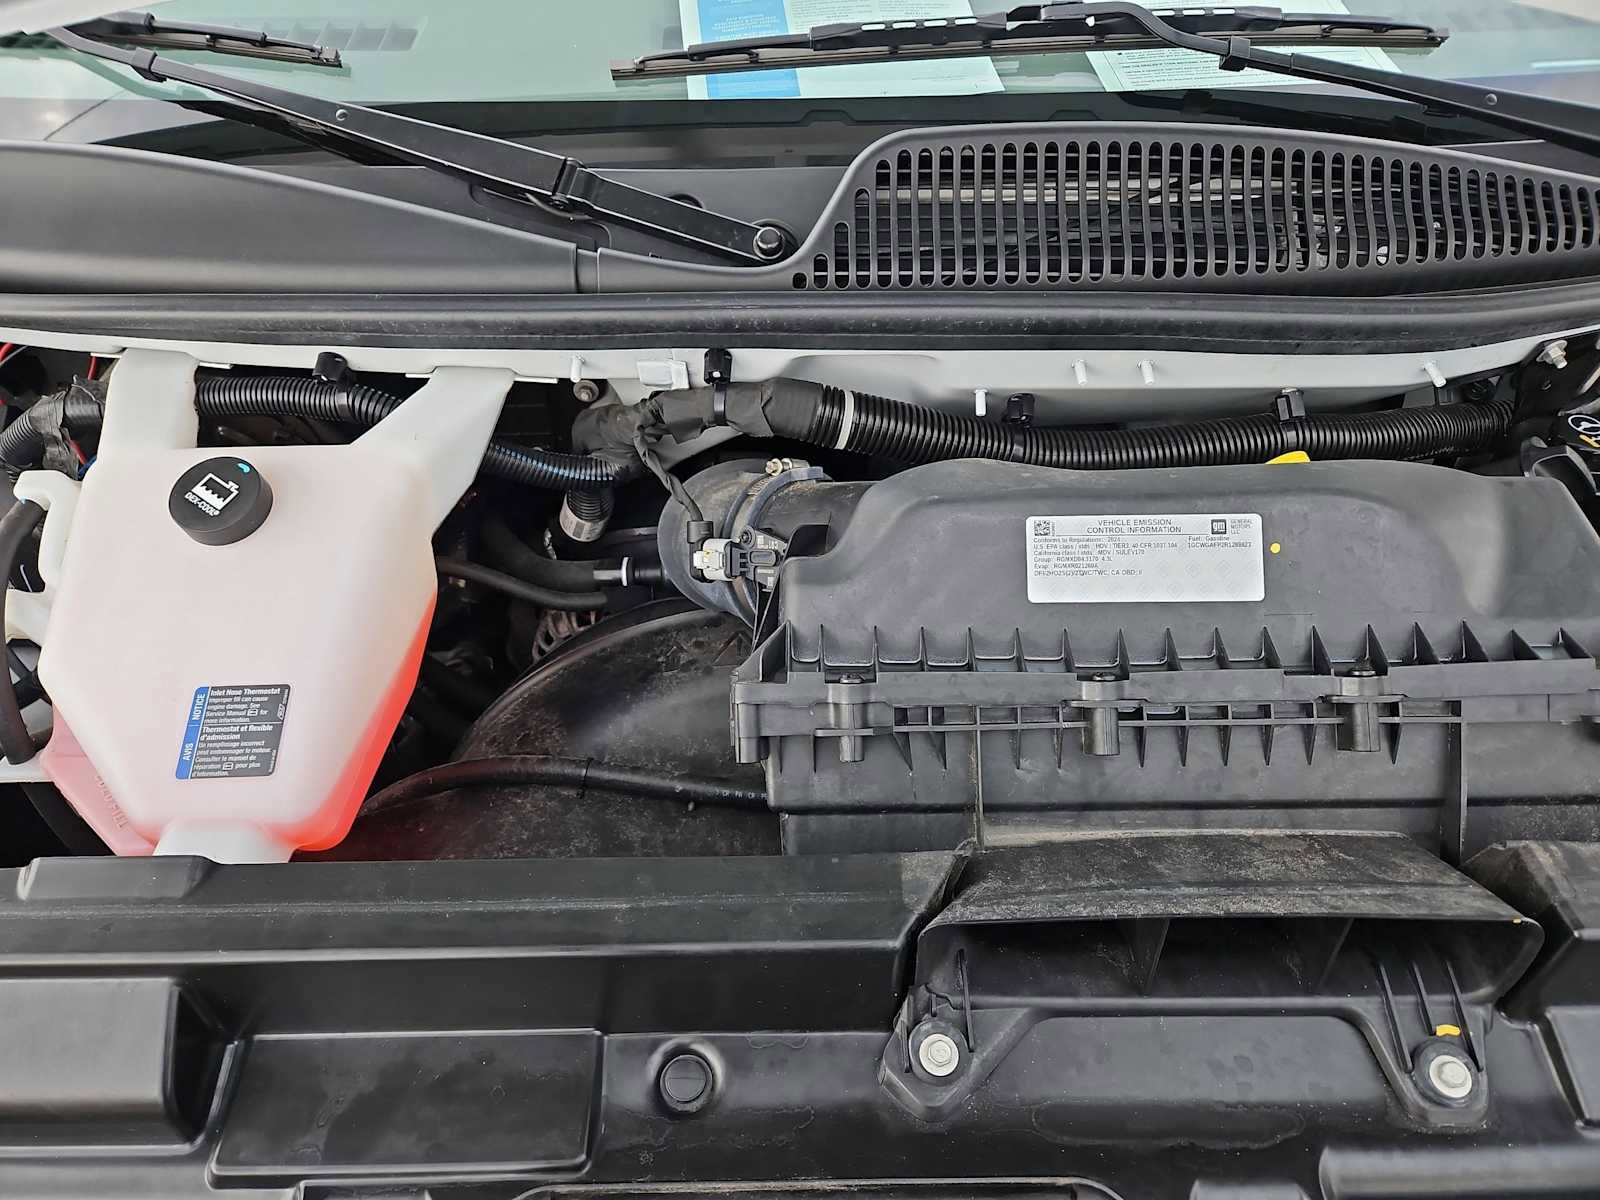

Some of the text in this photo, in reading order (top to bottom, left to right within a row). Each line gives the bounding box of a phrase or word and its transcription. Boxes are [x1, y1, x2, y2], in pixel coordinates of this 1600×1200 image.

[1134, 518, 1172, 526] EMISSION
[210, 689, 225, 697] Inlet
[192, 693, 206, 720] NOTICE
[200, 733, 240, 741] d'admission
[182, 743, 194, 761] AVIS
